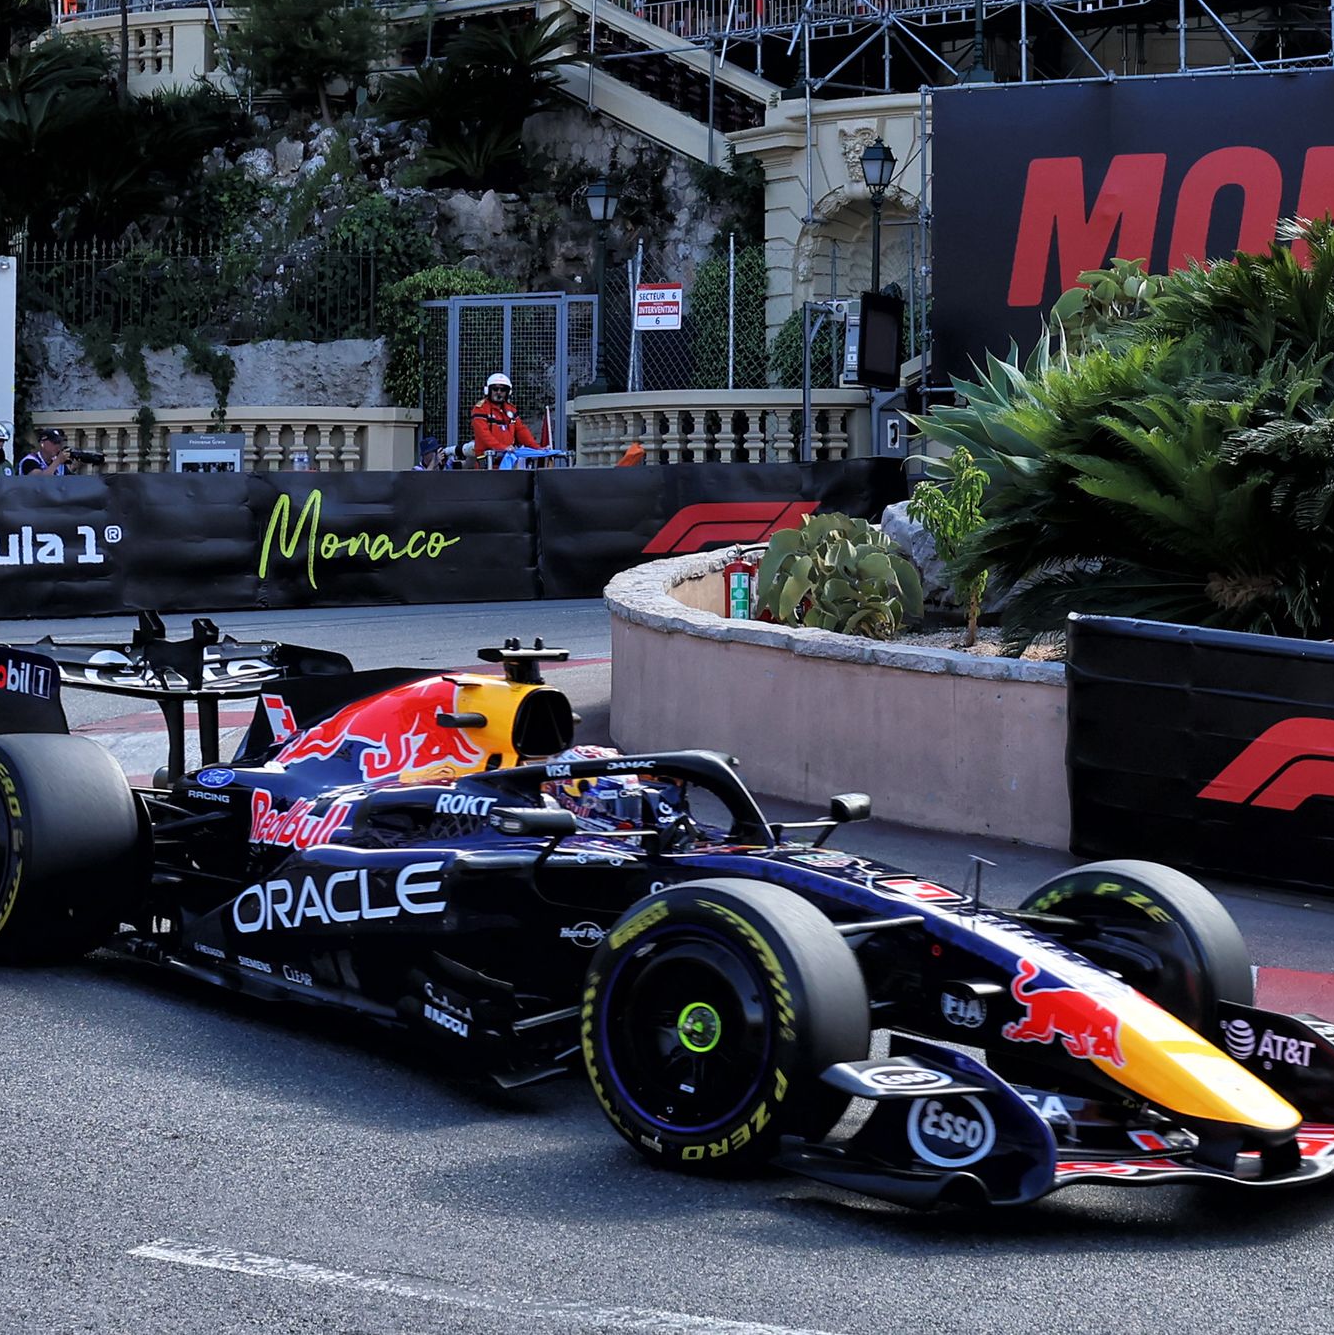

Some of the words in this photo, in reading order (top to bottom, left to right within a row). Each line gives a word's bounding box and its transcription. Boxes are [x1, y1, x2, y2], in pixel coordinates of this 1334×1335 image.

[638, 292, 666, 301] SECTEUR
[671, 291, 677, 300] 6
[638, 305, 679, 315] INTERVENTION
[654, 316, 661, 325] 6
[259, 489, 461, 590] Monaco
[201, 769, 230, 785] Ford
[546, 764, 571, 777] VISA
[188, 789, 230, 804] RACING
[435, 793, 498, 817] ROKT
[232, 860, 448, 934] ORACLE
[559, 926, 587, 939] Hard
[1257, 1031, 1317, 1067] AT&T
